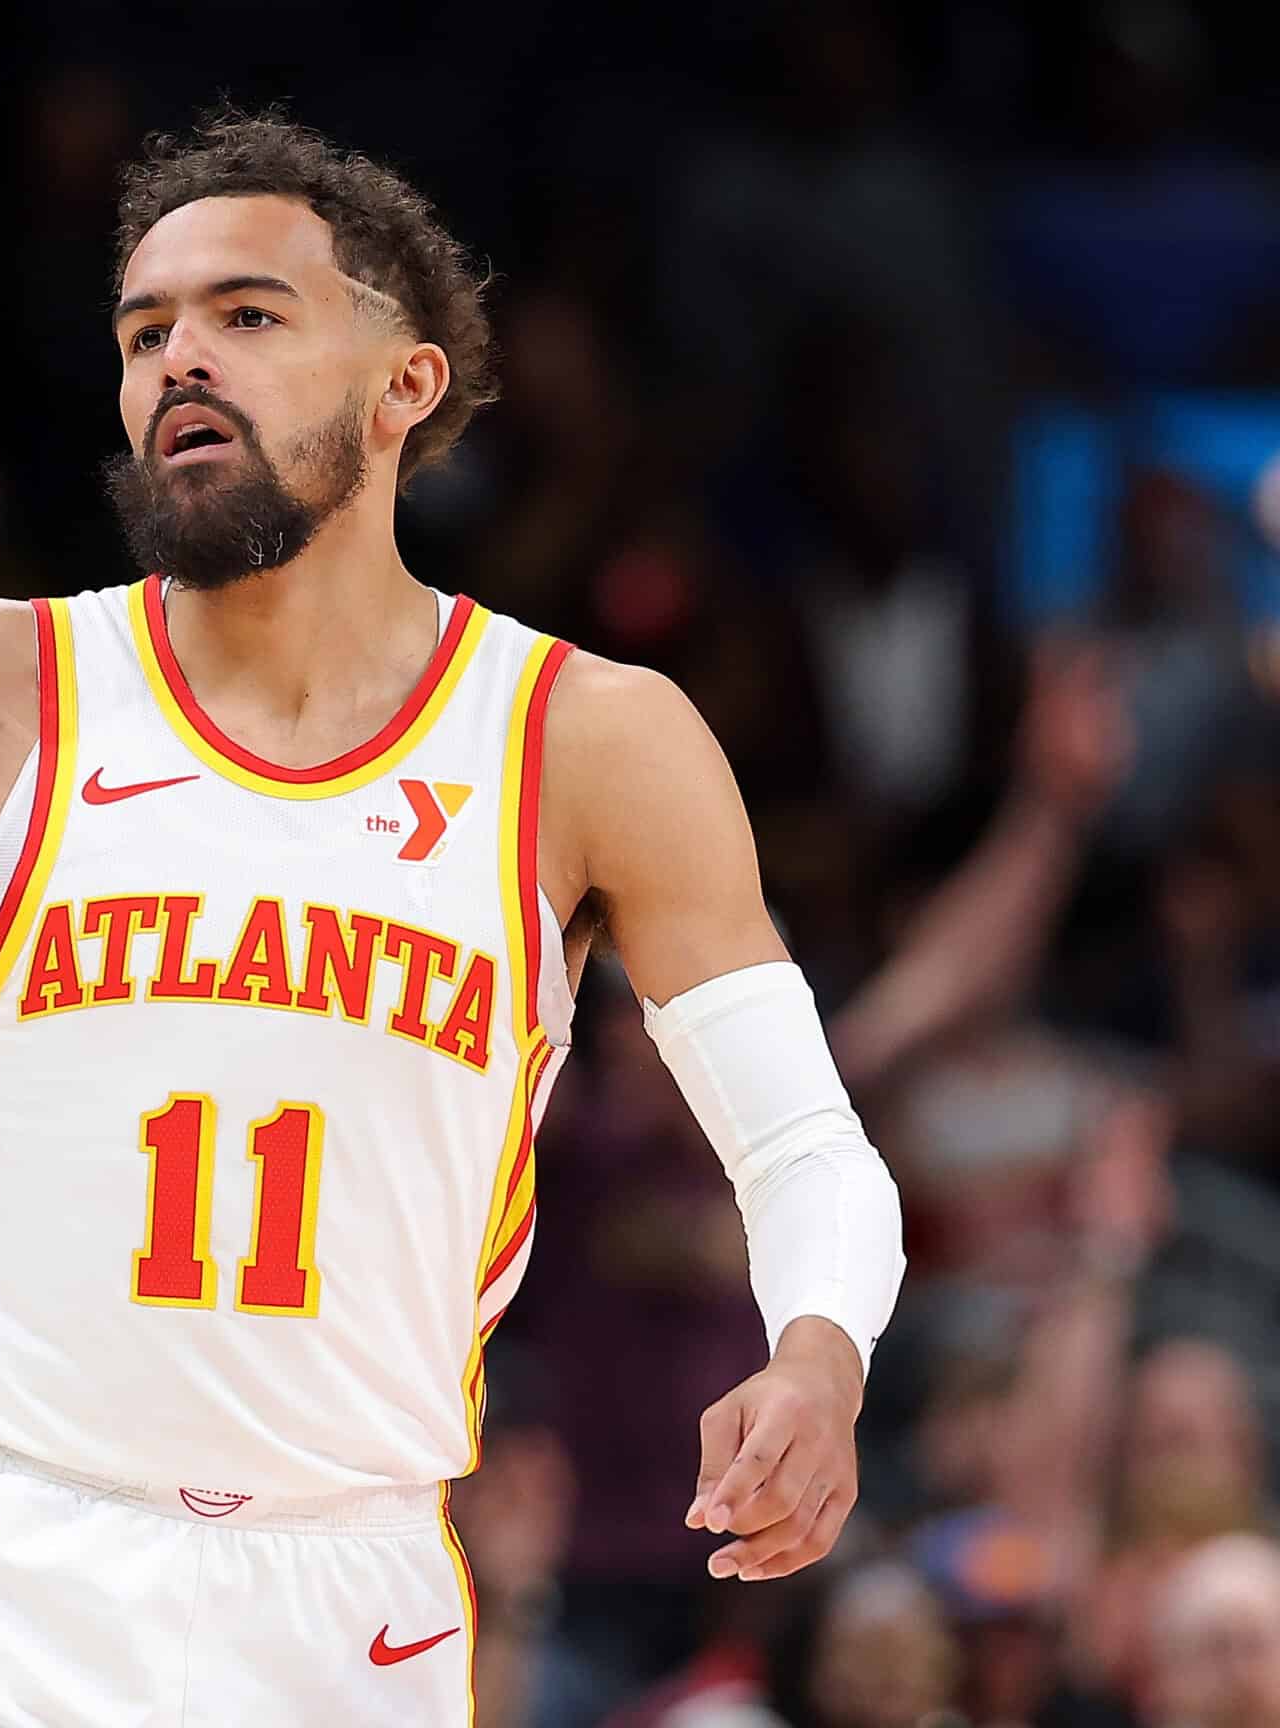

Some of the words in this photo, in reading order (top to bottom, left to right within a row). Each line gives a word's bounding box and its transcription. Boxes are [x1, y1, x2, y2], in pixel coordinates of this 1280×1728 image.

[365, 815, 401, 833] the
[17, 893, 497, 1075] ATLANTA
[129, 1091, 326, 1318] 11
